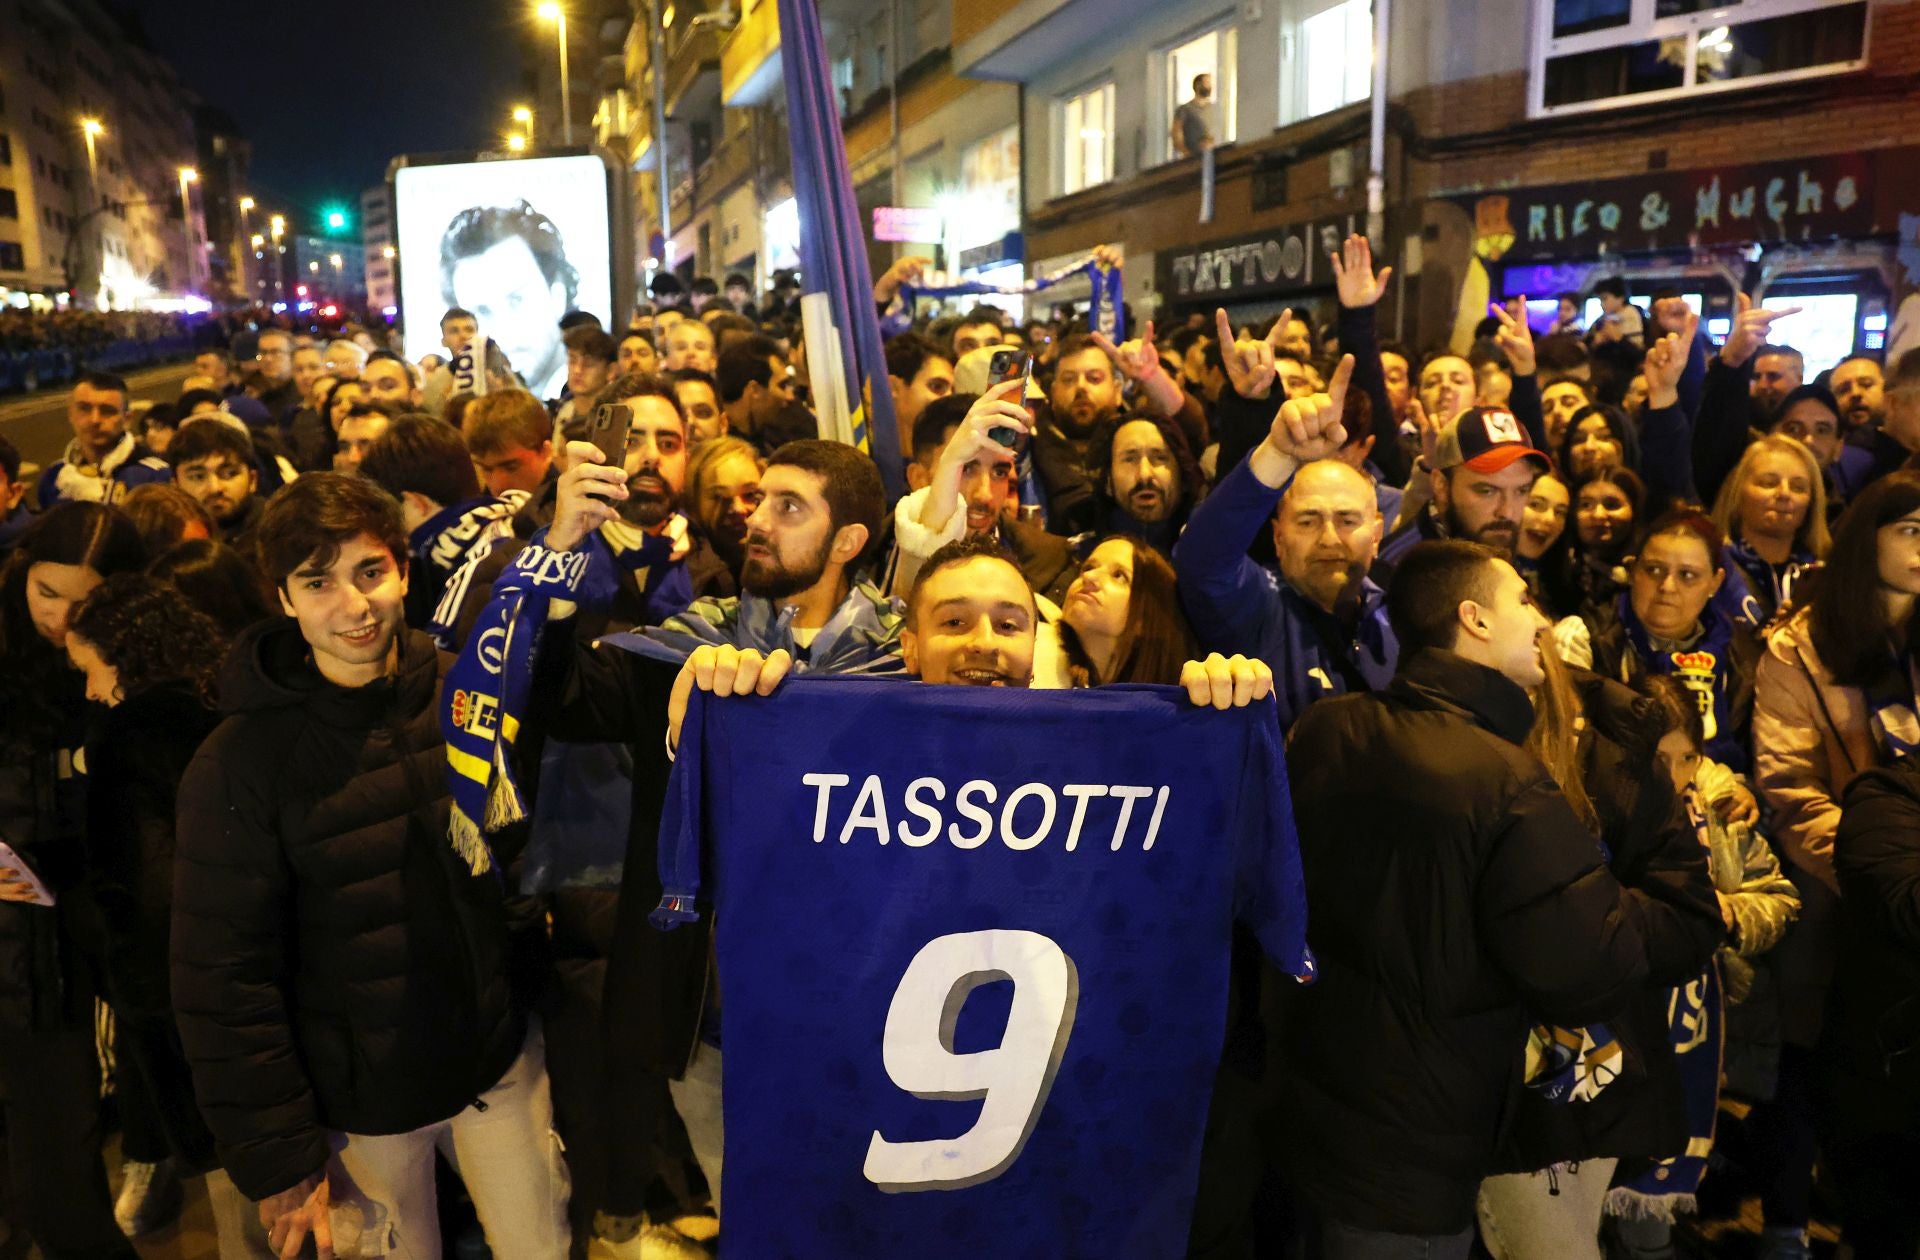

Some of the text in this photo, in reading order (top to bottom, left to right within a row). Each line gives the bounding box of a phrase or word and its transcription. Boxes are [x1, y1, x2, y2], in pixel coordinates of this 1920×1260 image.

[1640, 191, 1670, 231] &
[1173, 236, 1304, 295] TATTOO
[803, 773, 1170, 852] TASSOTTI
[863, 929, 1080, 1194] 9
